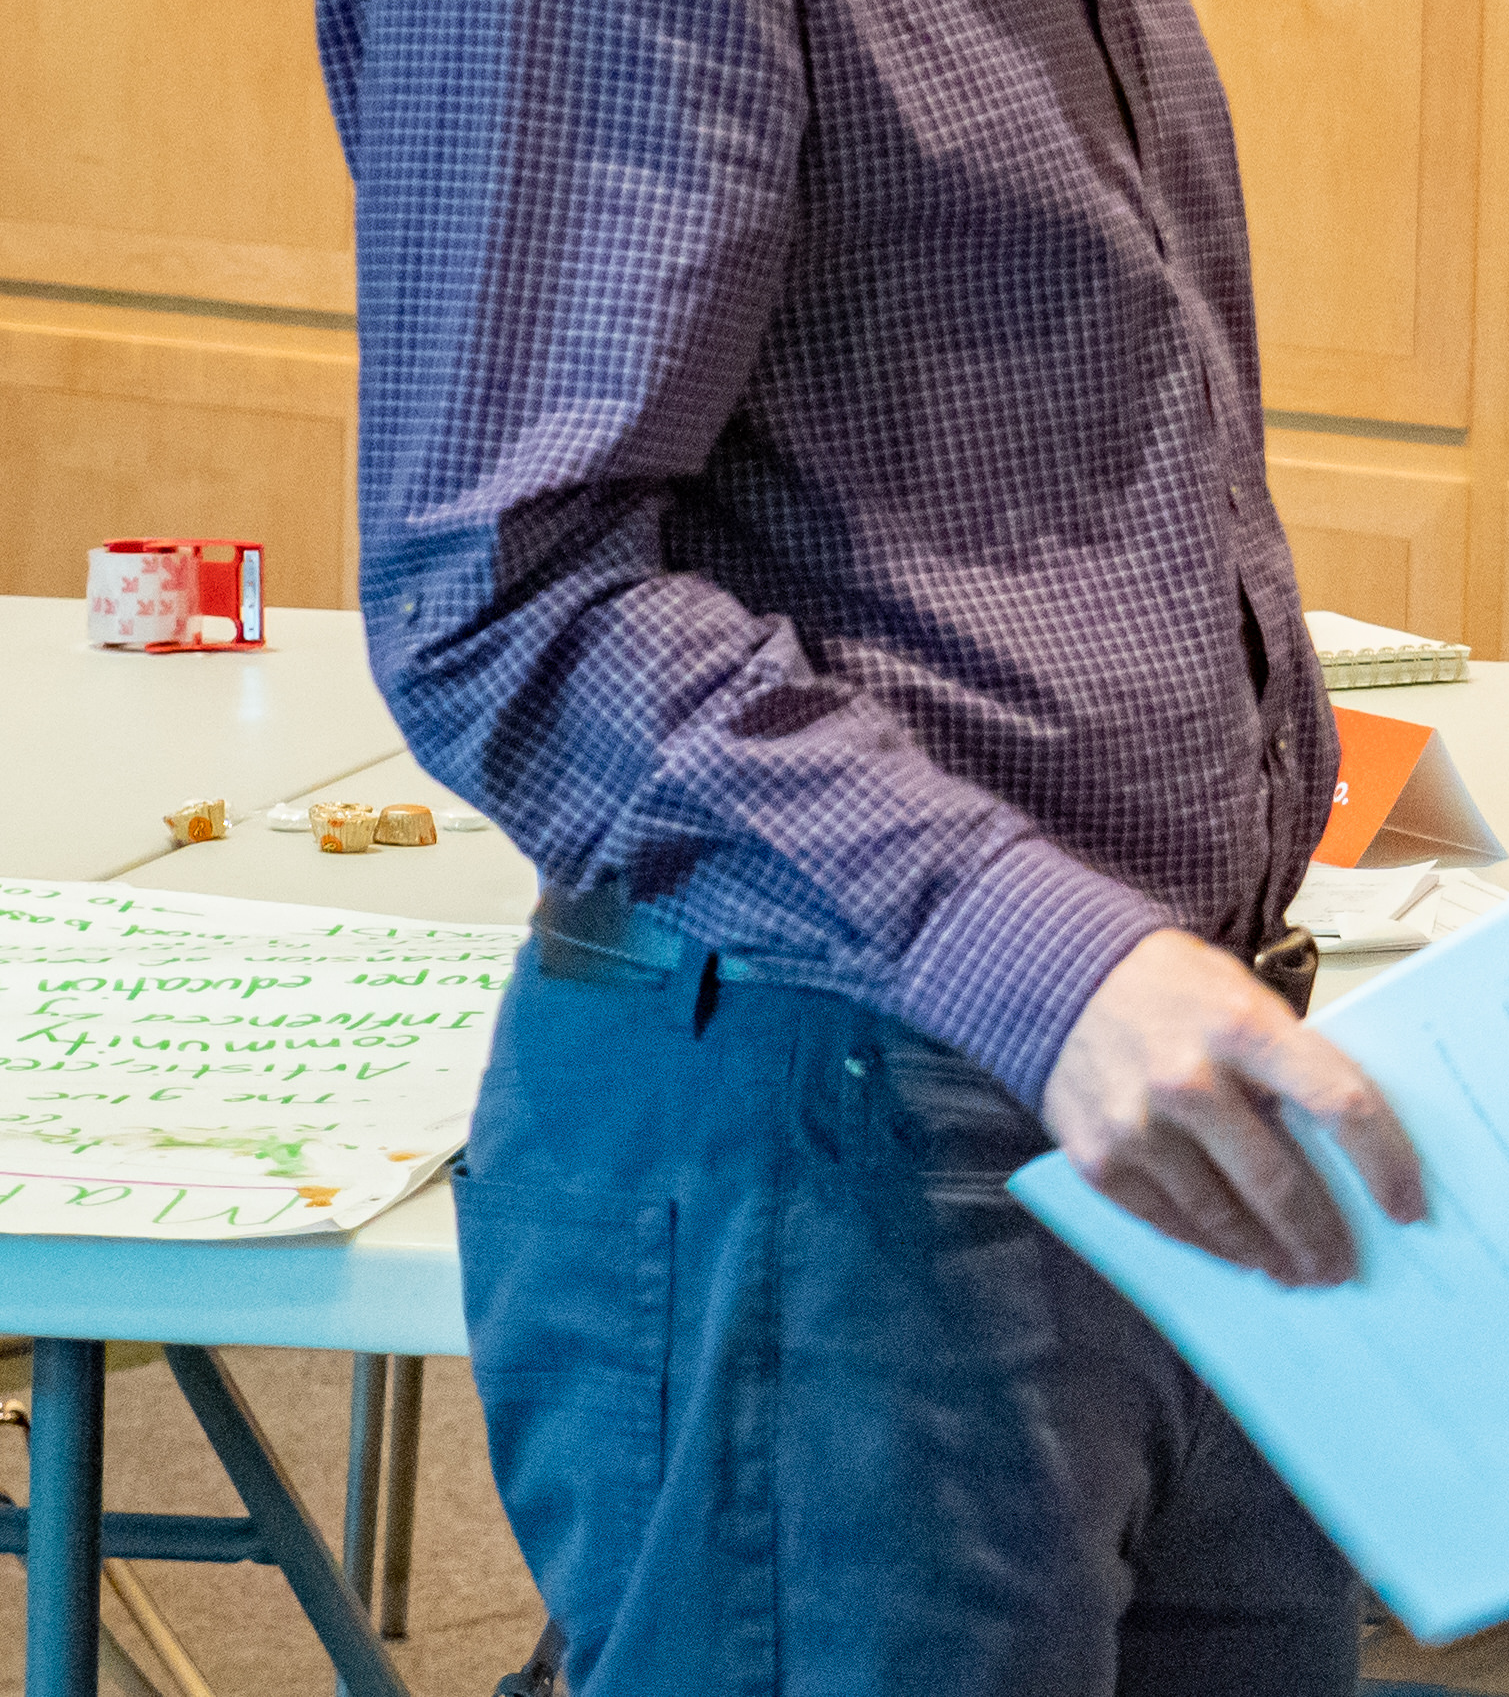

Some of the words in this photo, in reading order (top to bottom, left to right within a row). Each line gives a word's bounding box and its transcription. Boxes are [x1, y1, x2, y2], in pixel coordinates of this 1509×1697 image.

[37, 974, 313, 1001] education
[130, 1011, 486, 1032] Influenced
[16, 1021, 421, 1056] community
[26, 1086, 196, 1105] glue
[222, 1092, 343, 1104] The
